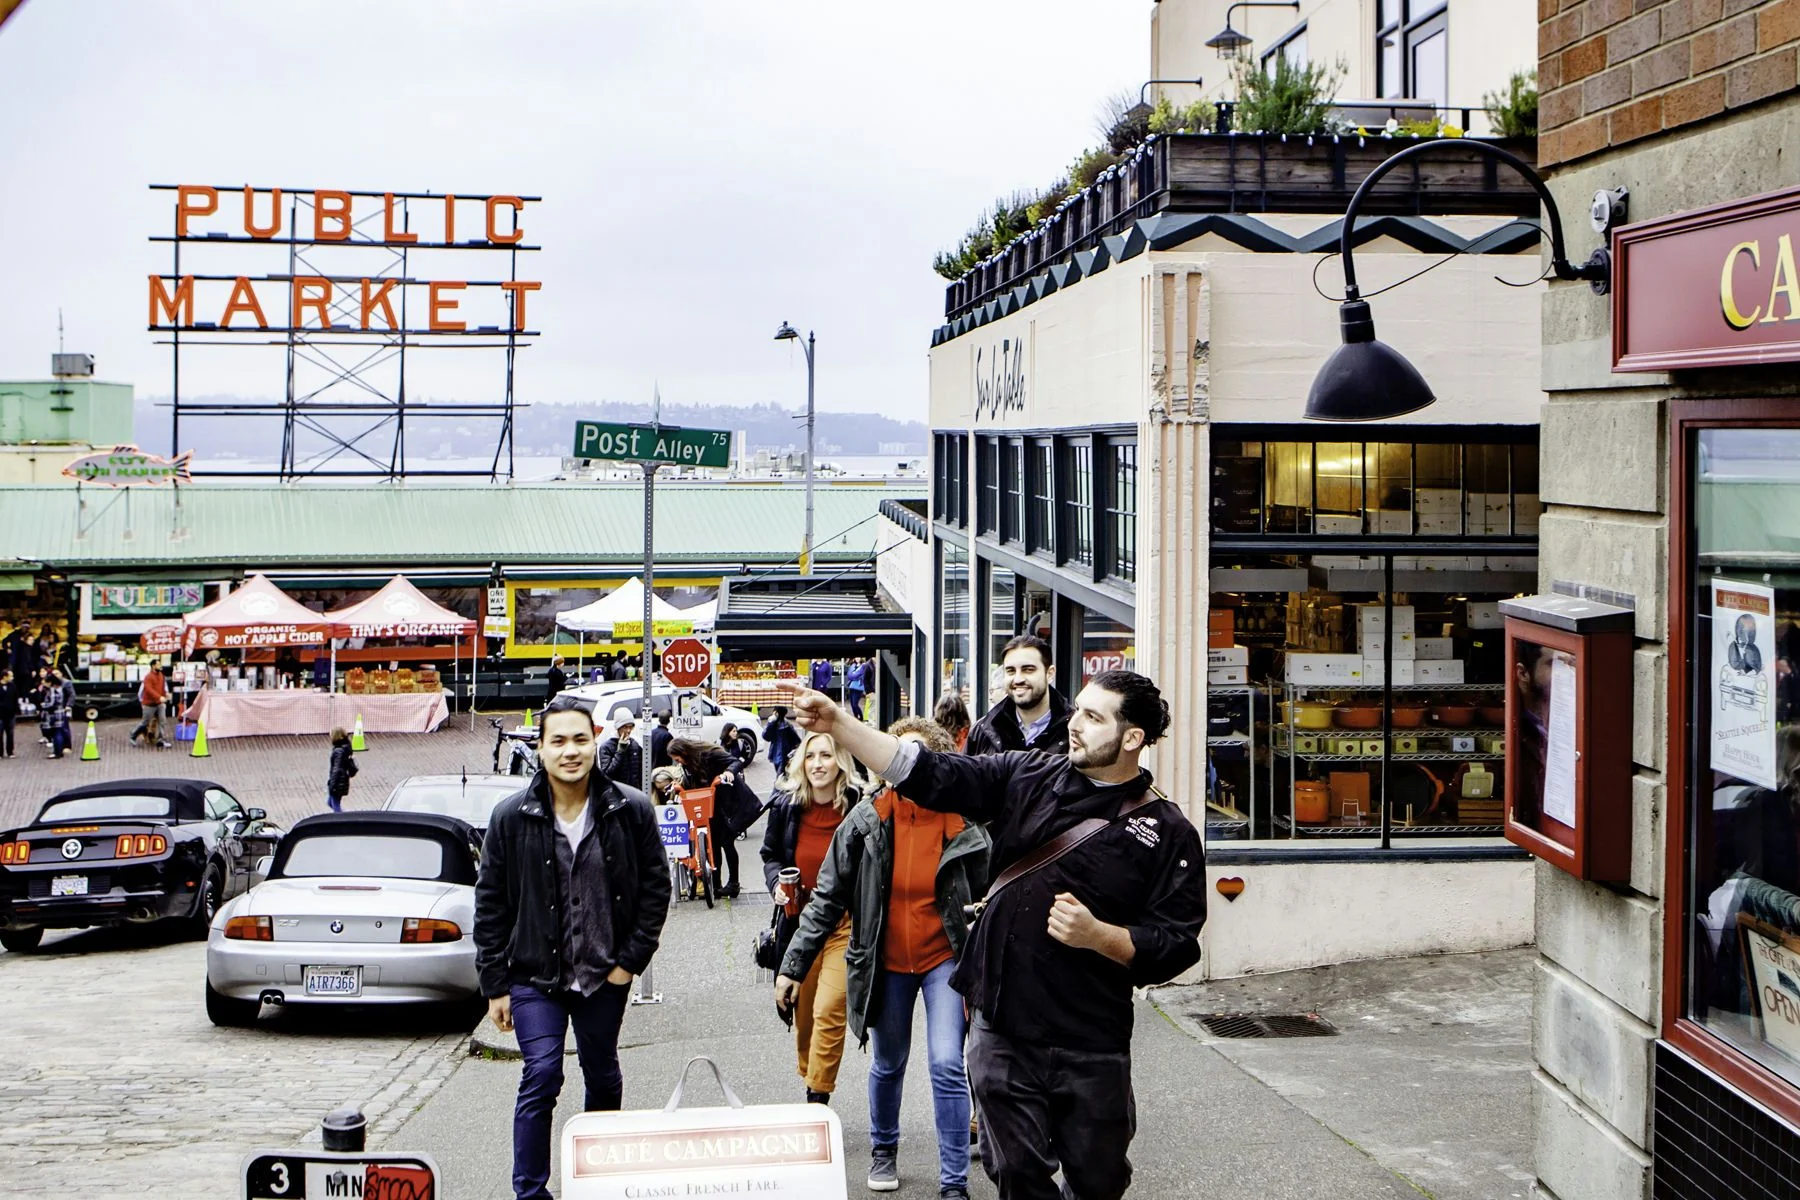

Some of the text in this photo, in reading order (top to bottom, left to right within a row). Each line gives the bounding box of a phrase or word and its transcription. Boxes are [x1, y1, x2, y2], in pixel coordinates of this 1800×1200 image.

[176, 184, 525, 245] PUBLIC
[148, 275, 542, 332] MARKET
[1003, 336, 1026, 422] Table
[581, 424, 727, 465] Post Alley 75
[95, 586, 201, 608] TULIPS
[224, 635, 249, 645] HOT
[251, 633, 287, 645] APPLE
[288, 631, 324, 643] CIDER
[244, 625, 297, 634] ORGANIC
[350, 623, 465, 637] TINY'S ORGANIC
[665, 653, 708, 673] STOP
[661, 835, 682, 843] Park
[310, 976, 354, 990] ATR7366
[585, 1132, 820, 1167] CAFÉ CAMPAGNE
[270, 1162, 363, 1197] 3 MIN
[624, 1184, 680, 1199] CLASSIC
[686, 1181, 740, 1196] FRENCH
